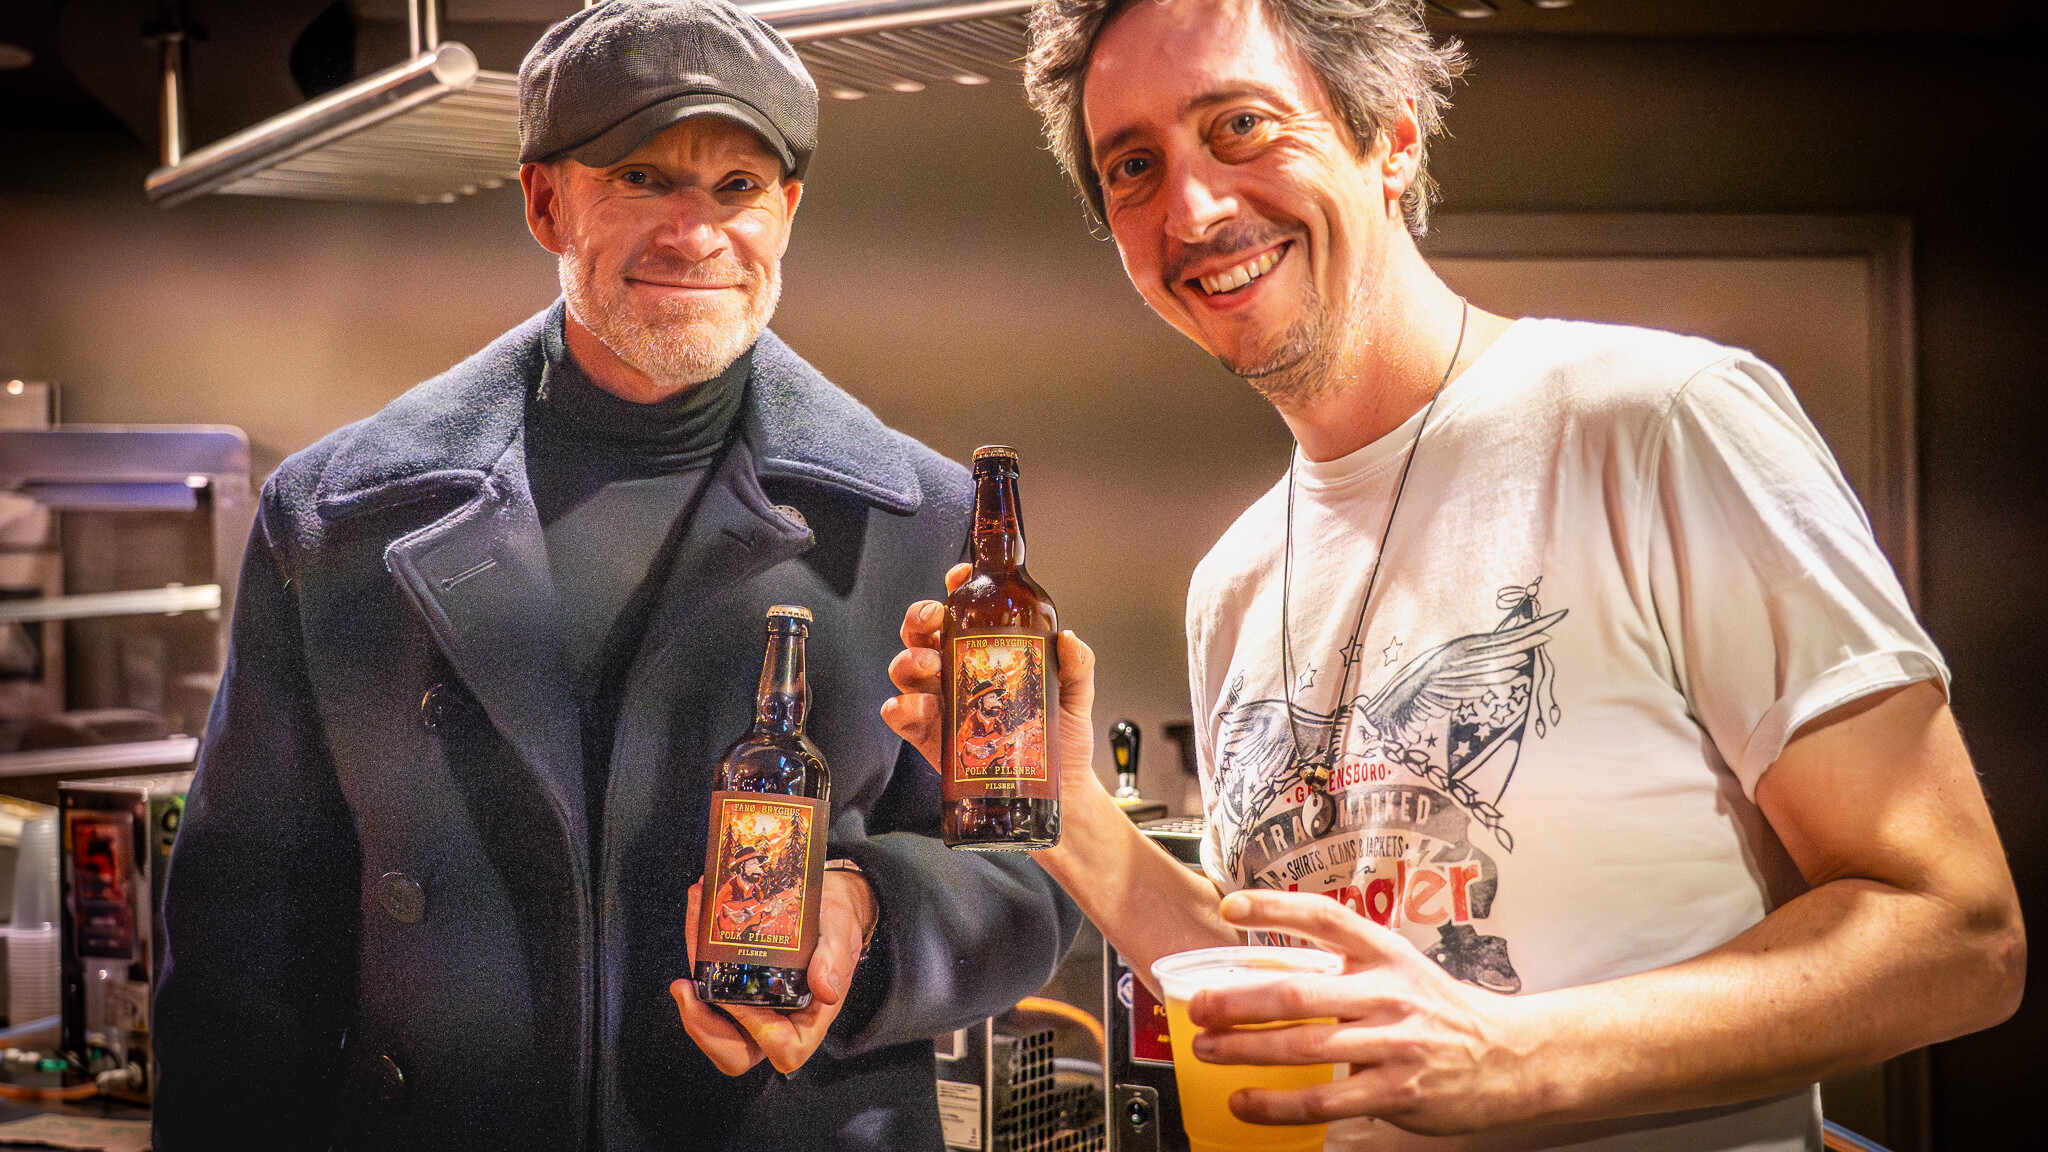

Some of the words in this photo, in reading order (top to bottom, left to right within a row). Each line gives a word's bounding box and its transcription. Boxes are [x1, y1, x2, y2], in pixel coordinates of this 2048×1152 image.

[994, 638, 1033, 648] BRYGHUS
[965, 766, 988, 776] FOLK
[994, 766, 1036, 776] PILSNER
[985, 782, 1016, 790] PILSNER
[1294, 762, 1386, 803] GENSBORO
[761, 805, 801, 817] BRYGHUS
[1255, 790, 1431, 861] TRAMARKED
[1327, 839, 1357, 866] JEANS
[1364, 835, 1404, 859] JACKETS
[719, 930, 742, 941] FOLK
[748, 932, 790, 945] PILSNER
[737, 948, 768, 958] PILSNER
